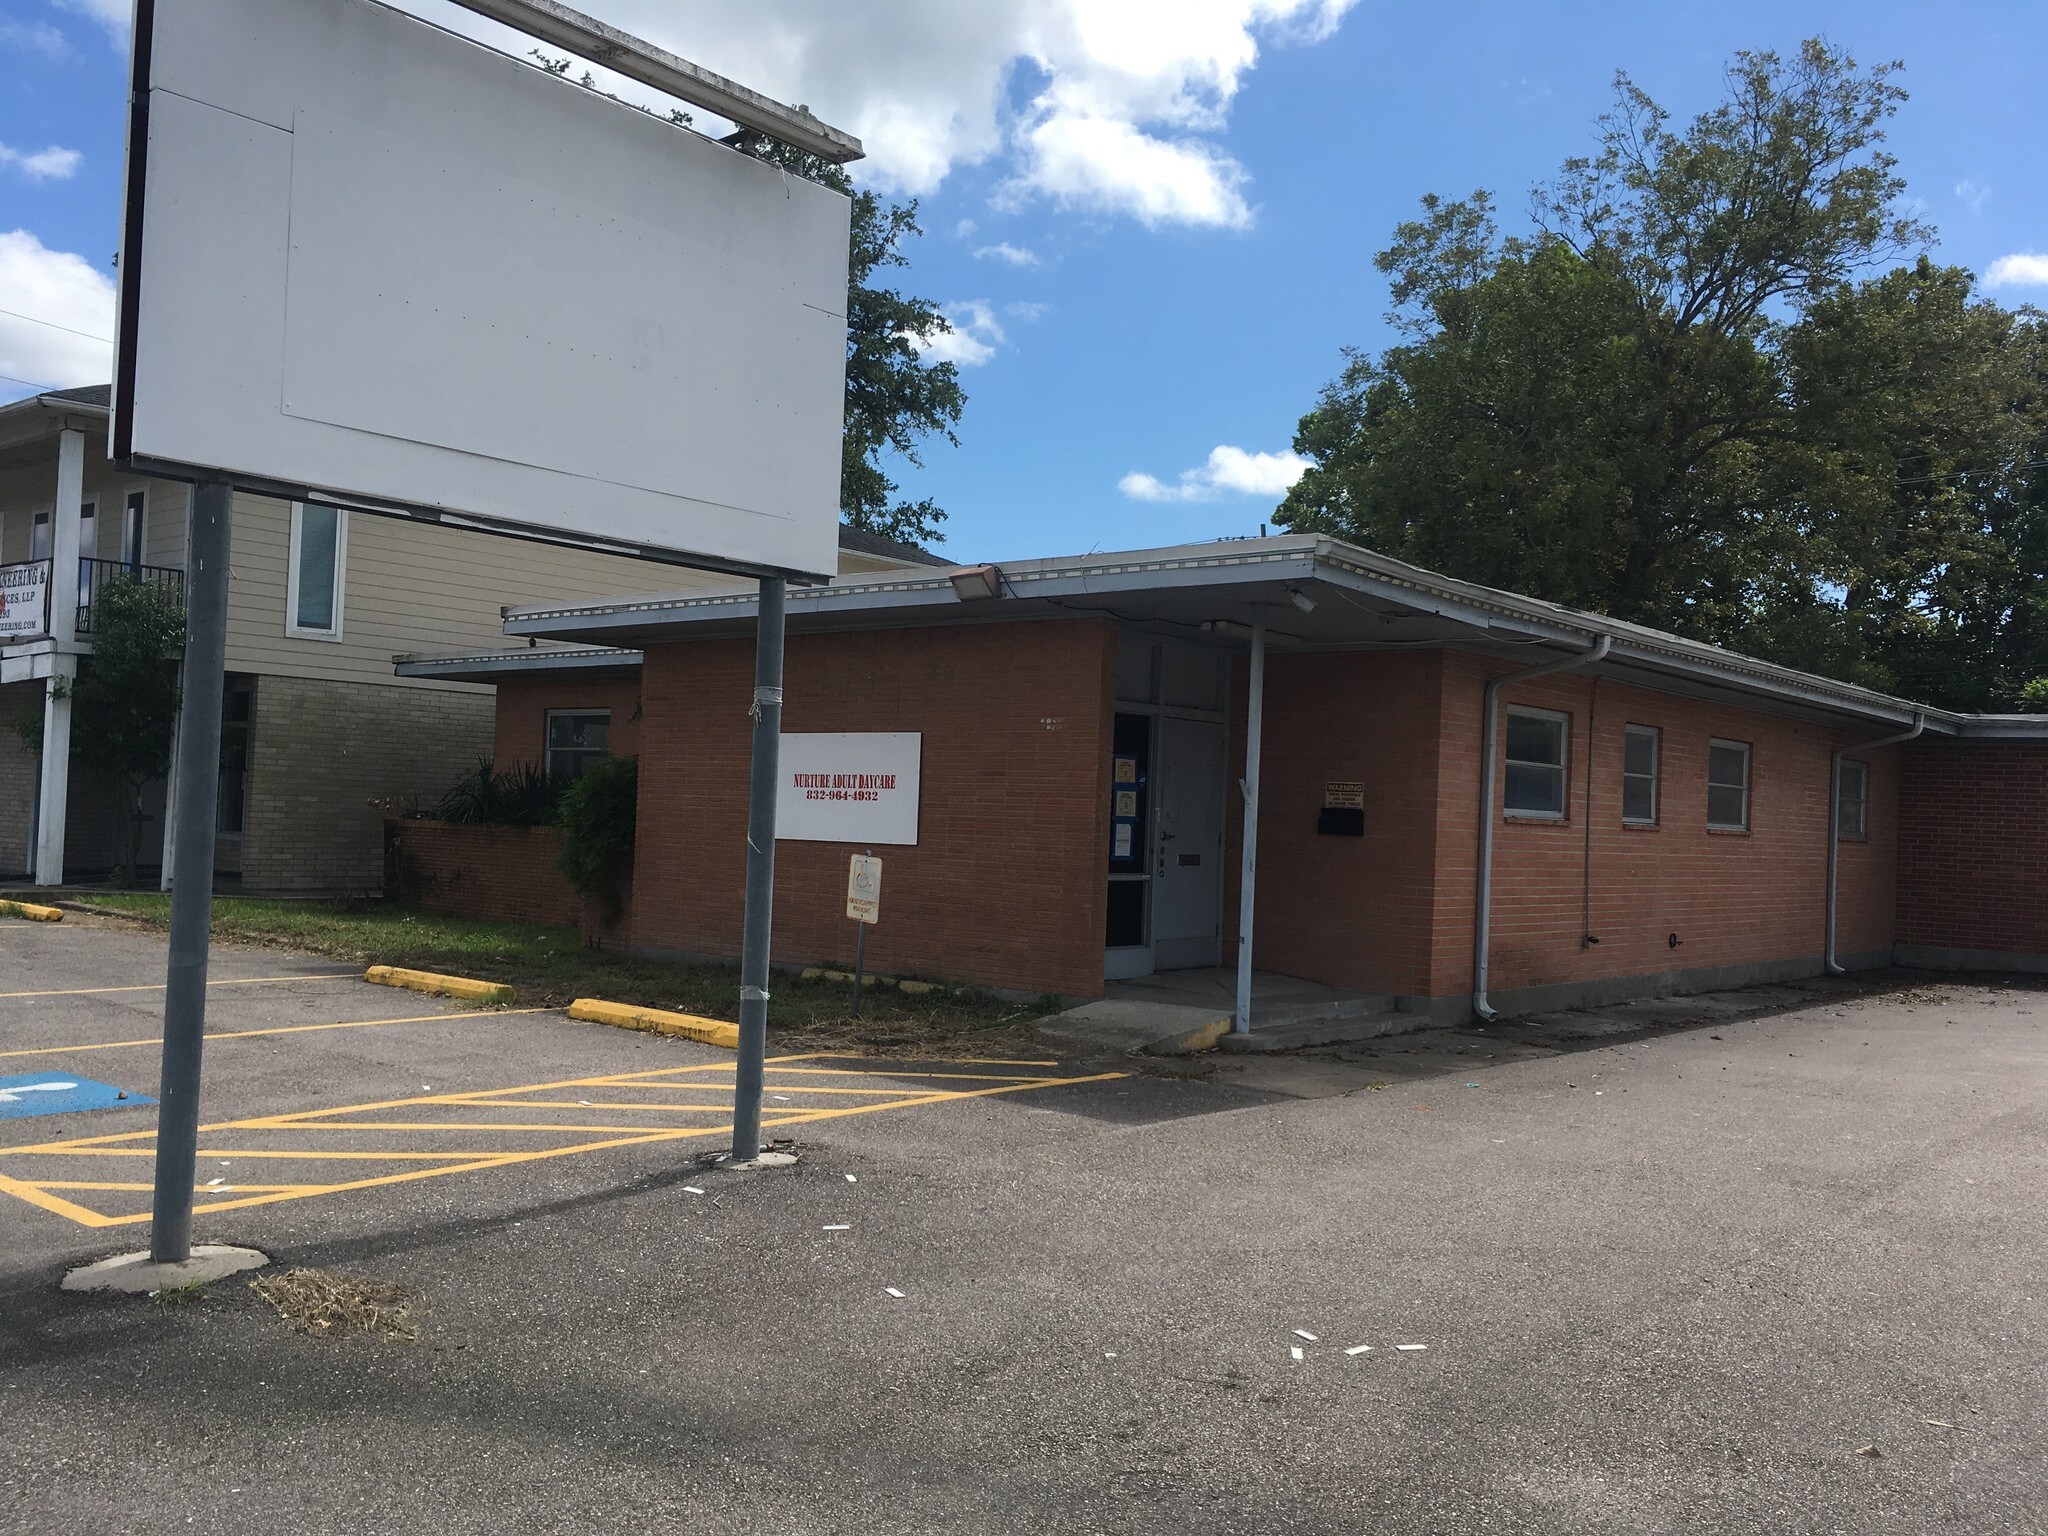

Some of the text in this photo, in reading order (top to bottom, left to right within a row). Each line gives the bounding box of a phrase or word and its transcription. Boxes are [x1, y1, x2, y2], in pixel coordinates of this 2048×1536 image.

[39, 566, 46, 584] &
[22, 591, 36, 602] LLP
[793, 773, 896, 789] NURTURE ADULT DAYCARE
[1328, 784, 1363, 792] WARNING
[806, 790, 878, 801] 832-964-4932
